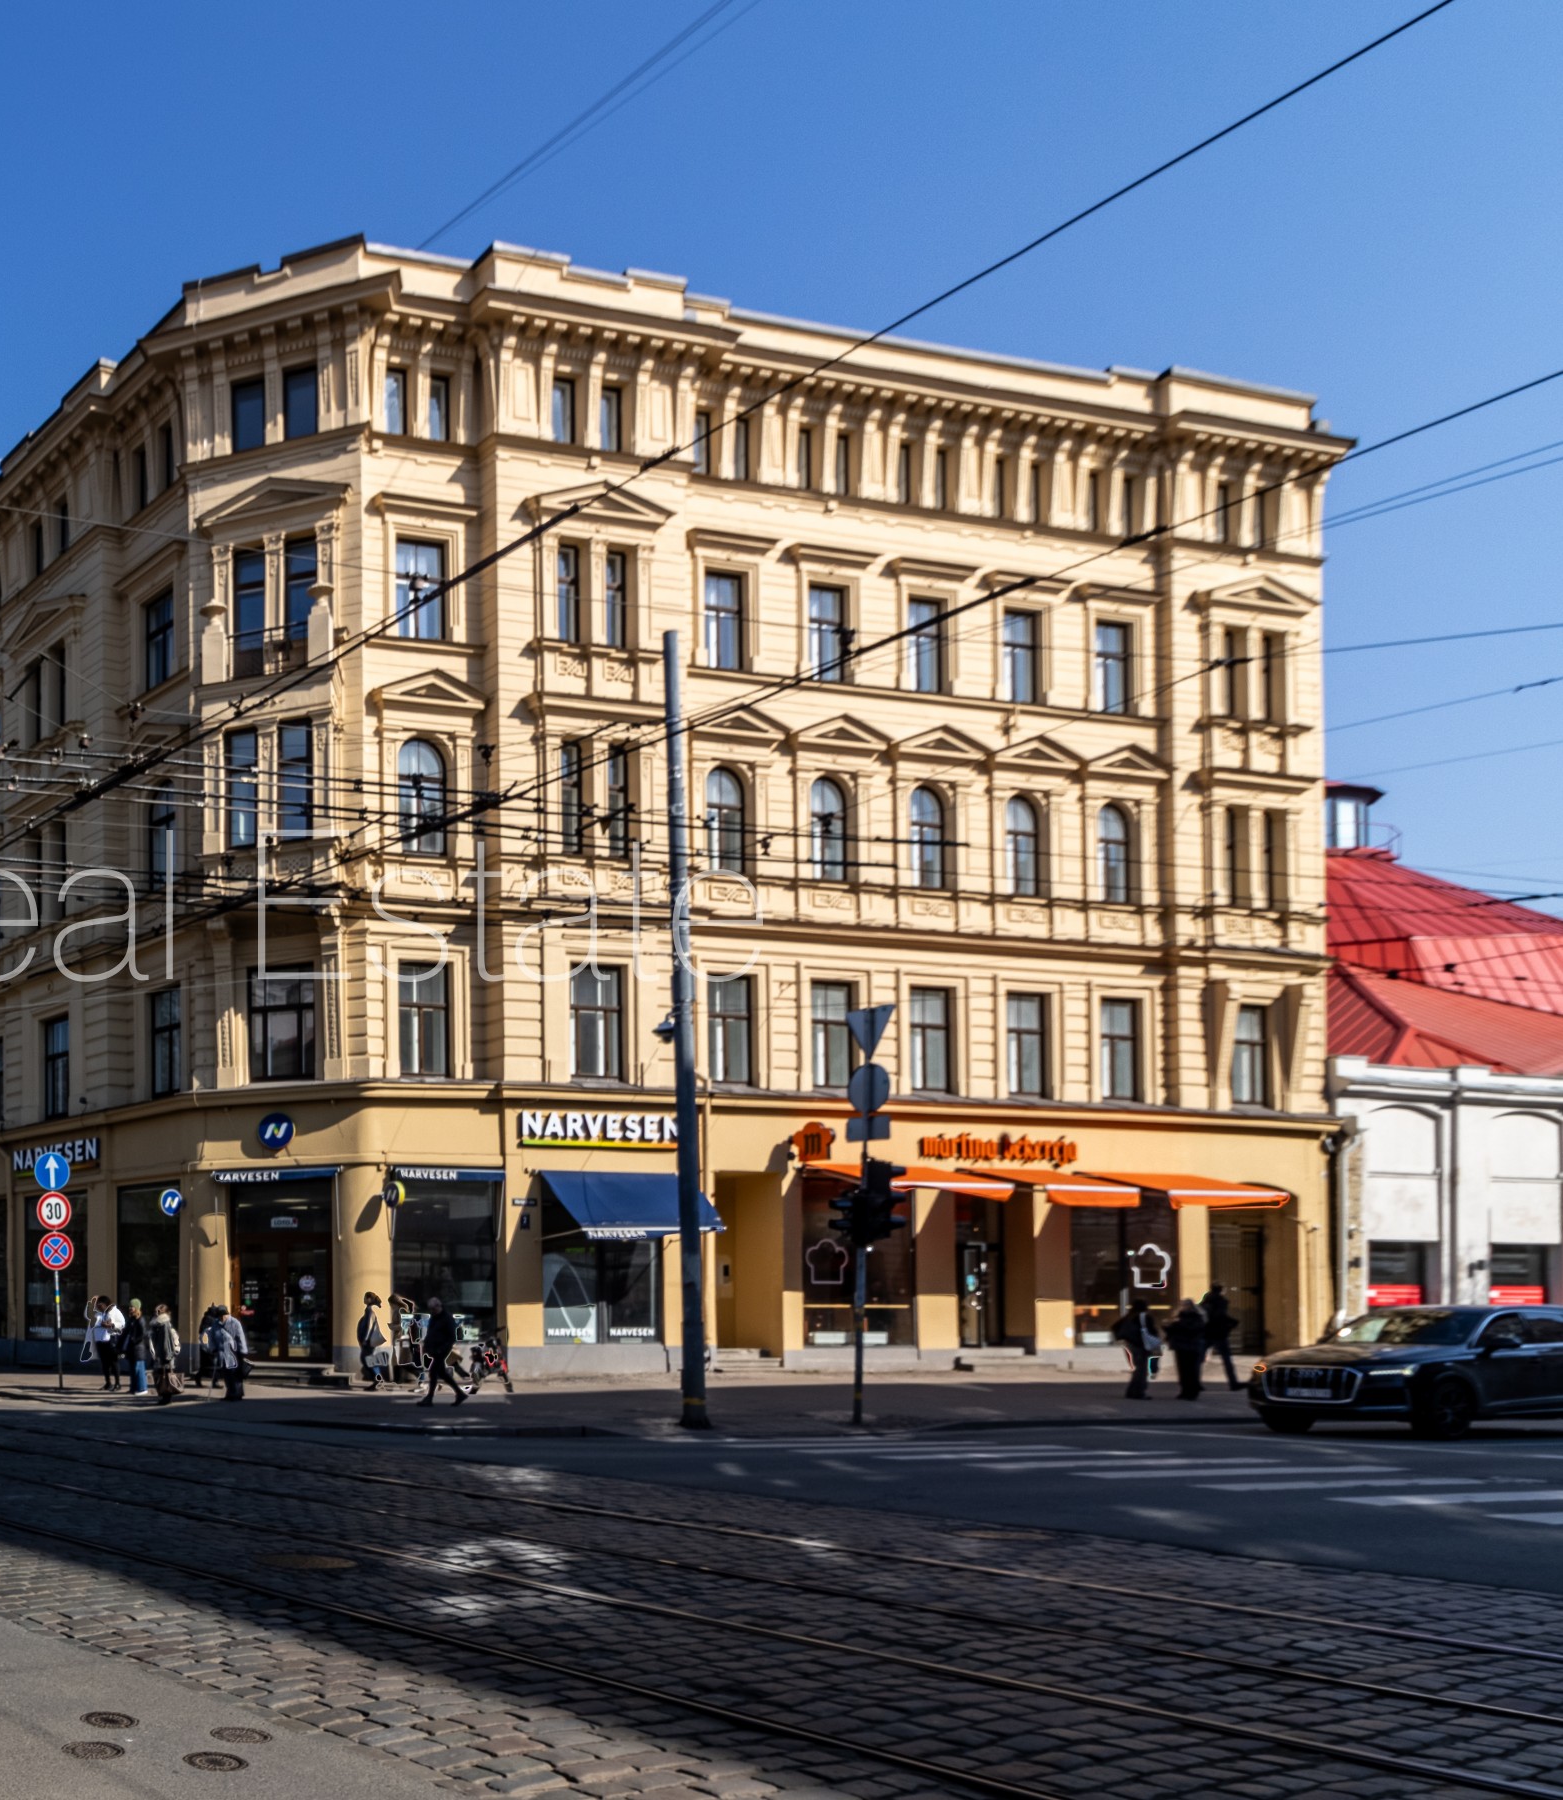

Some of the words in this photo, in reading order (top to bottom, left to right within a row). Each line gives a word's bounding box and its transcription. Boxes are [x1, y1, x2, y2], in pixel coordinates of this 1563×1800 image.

[522, 1110, 679, 1142] NARVESEN
[13, 1137, 97, 1170] NARESEN
[401, 1168, 458, 1181] NARVESEN
[45, 1202, 62, 1220] 30
[588, 1230, 647, 1240] NARVESEN
[547, 1328, 594, 1337] NARVESEN
[609, 1327, 655, 1337] NARVESEN
